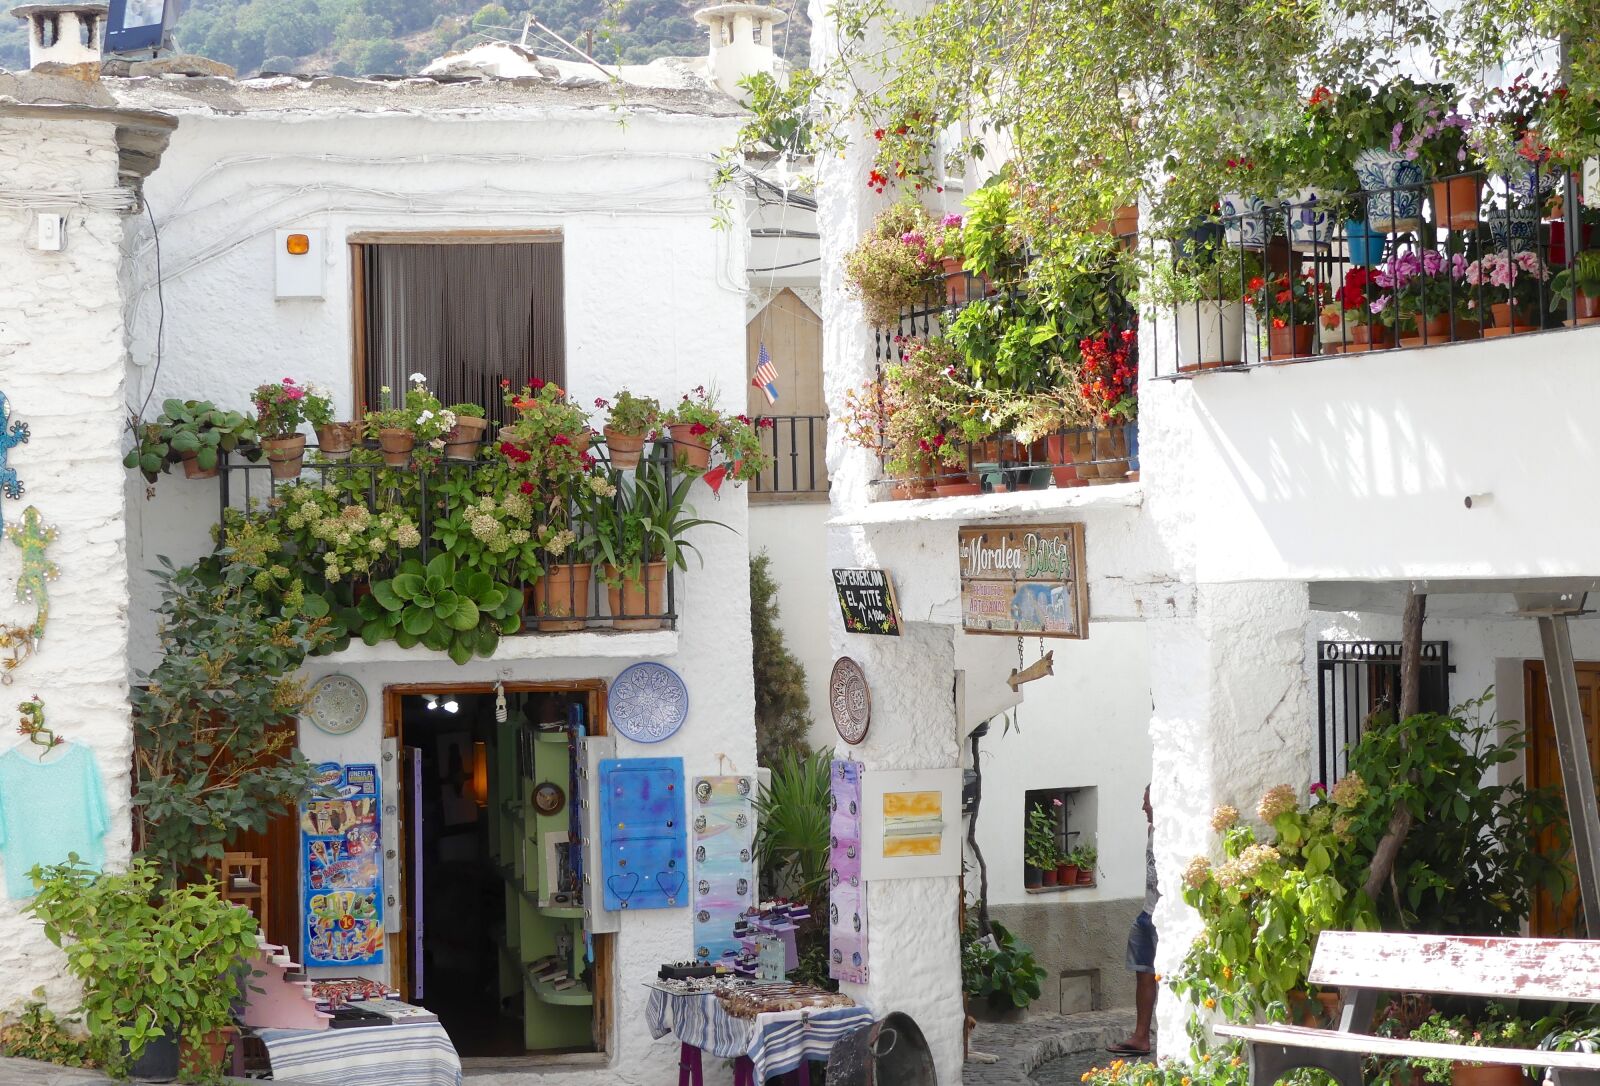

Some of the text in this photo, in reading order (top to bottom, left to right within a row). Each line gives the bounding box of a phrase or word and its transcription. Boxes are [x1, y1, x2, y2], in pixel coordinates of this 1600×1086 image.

[834, 570, 884, 587] SUPERMERCADO
[845, 589, 883, 607] EL TITE
